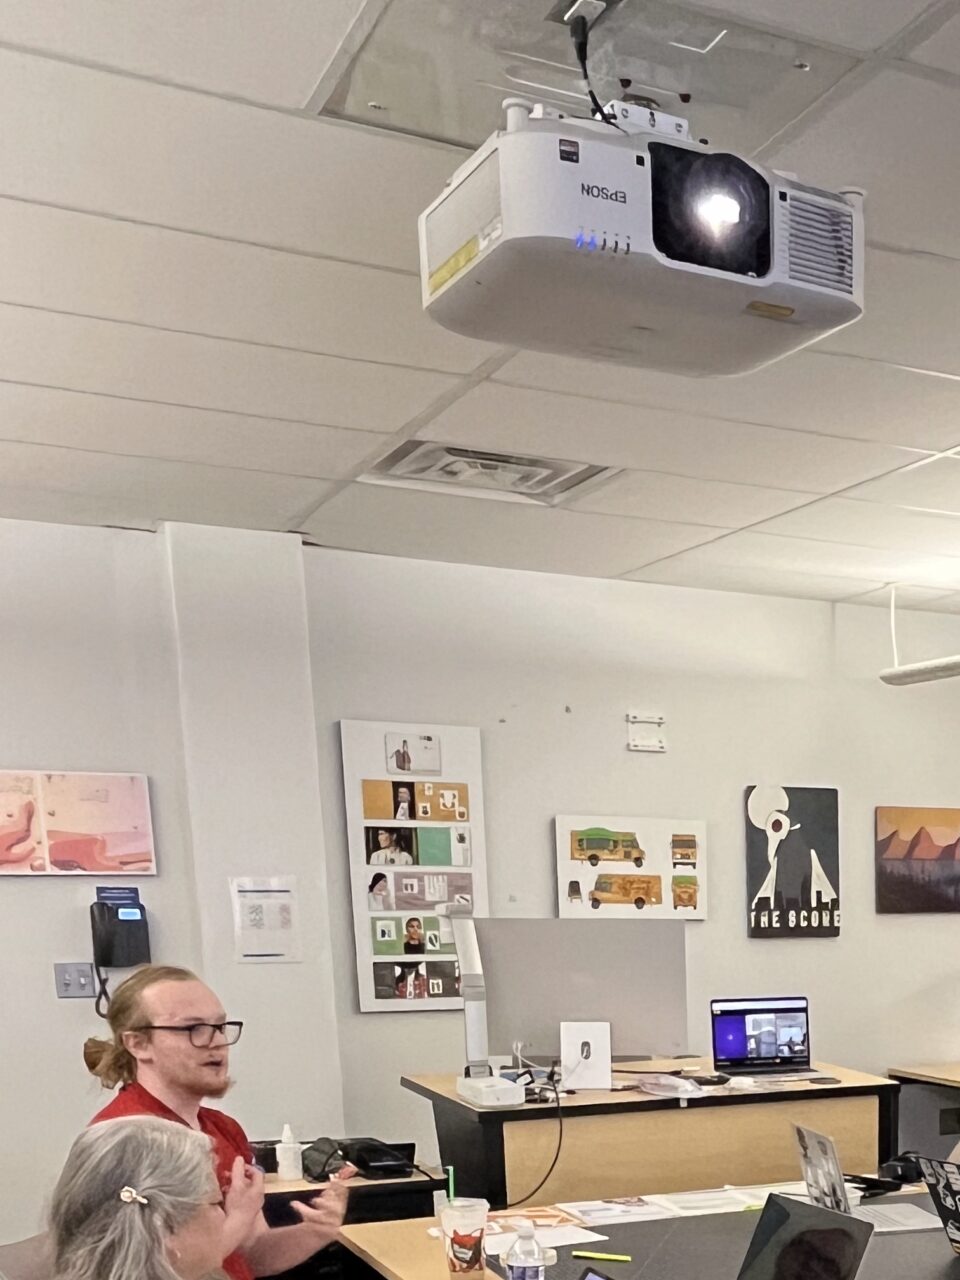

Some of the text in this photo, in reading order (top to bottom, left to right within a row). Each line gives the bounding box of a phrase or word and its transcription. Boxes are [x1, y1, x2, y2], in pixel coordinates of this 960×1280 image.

[581, 182, 627, 204] EPSON
[750, 910, 841, 928] THE SCORE
